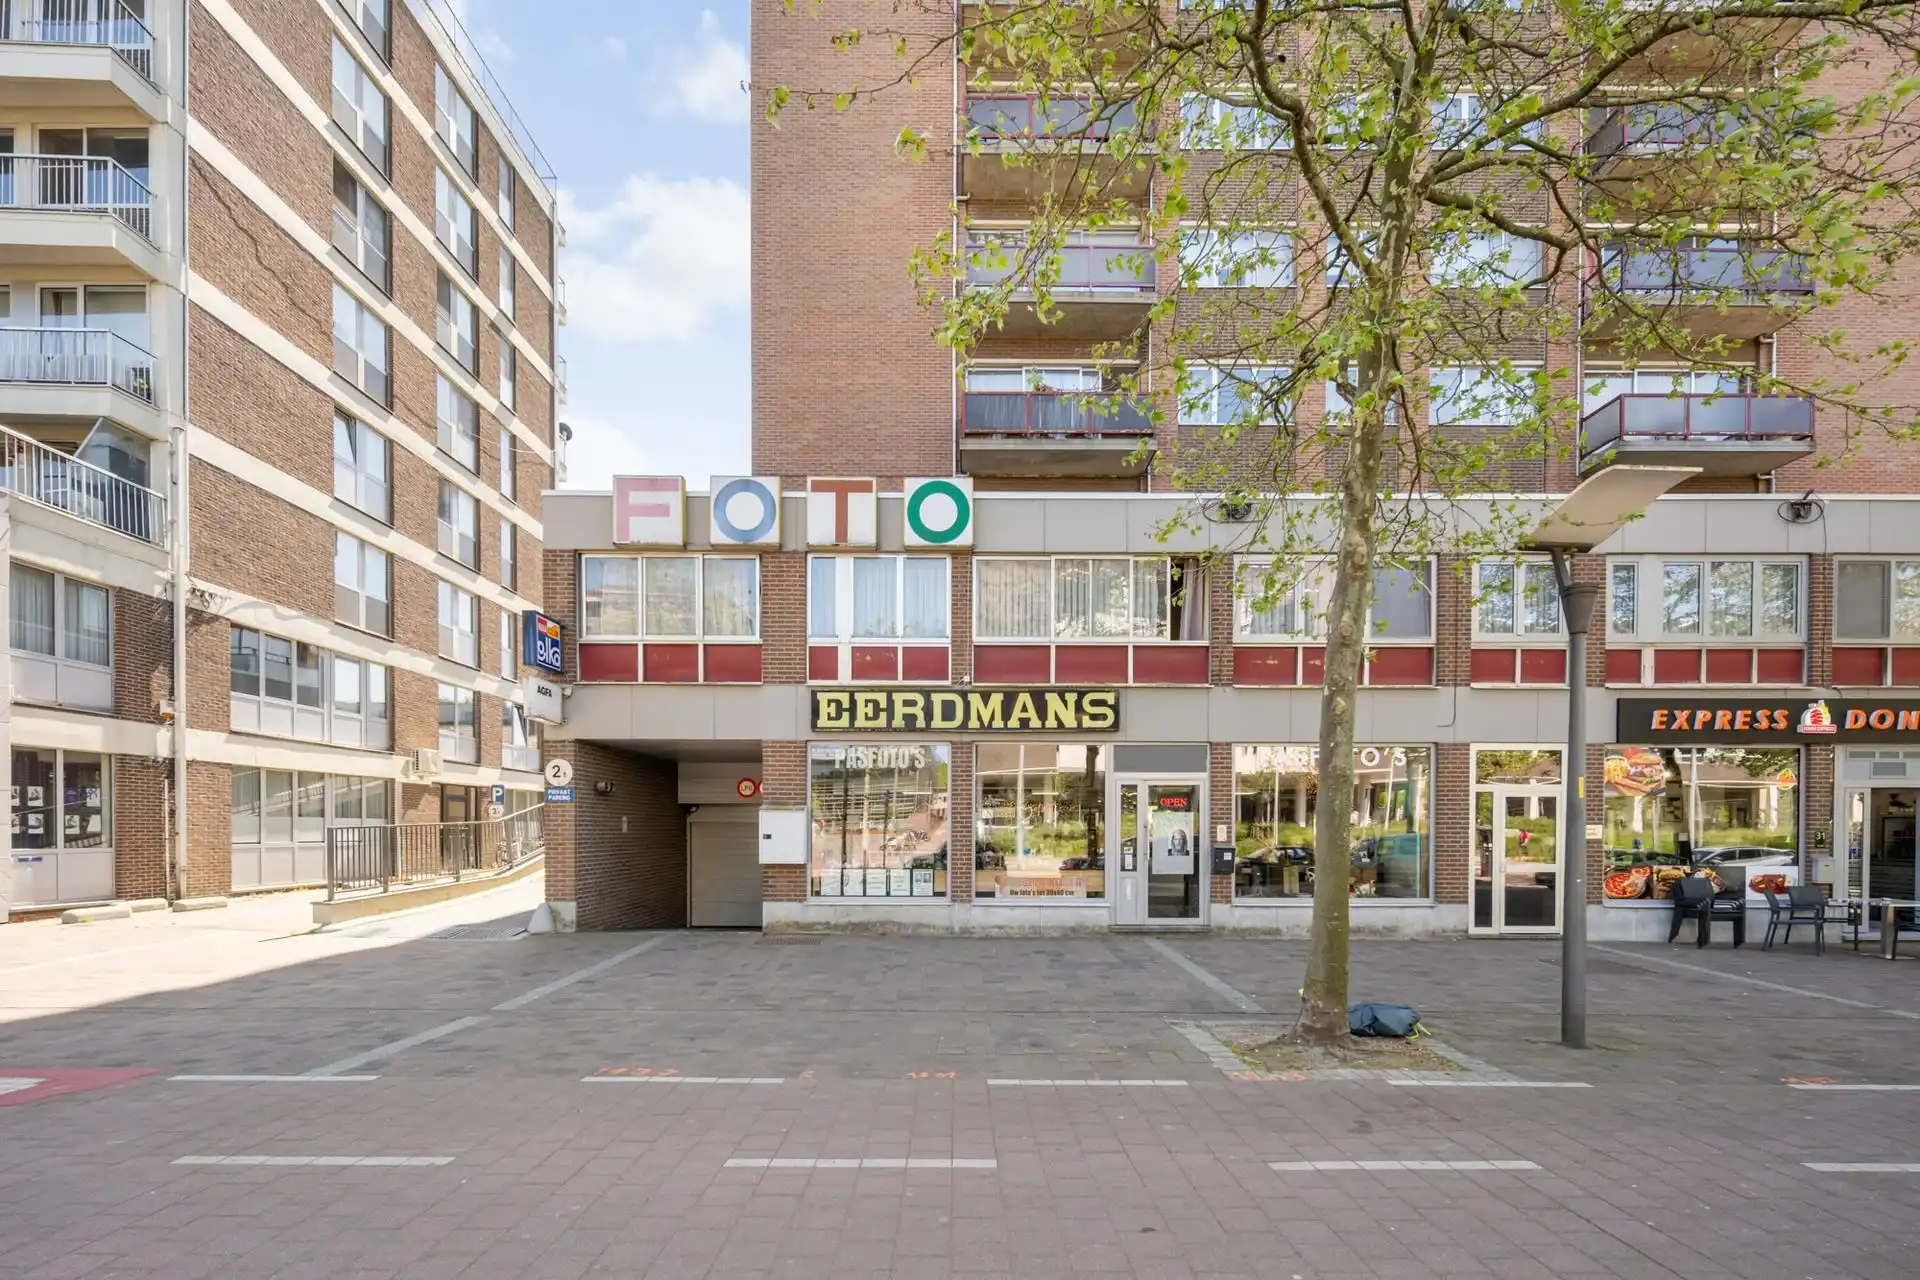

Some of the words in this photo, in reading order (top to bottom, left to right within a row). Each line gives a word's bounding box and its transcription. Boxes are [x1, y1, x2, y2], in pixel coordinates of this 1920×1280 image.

[614, 477, 971, 545] FOTO
[537, 684, 553, 698] AGFA
[816, 692, 1116, 729] EERDMANS
[1651, 708, 1790, 731] EXPRESS
[834, 745, 927, 769] PASFOTO'S
[492, 787, 503, 802] P
[1160, 797, 1188, 807] OPEN
[1815, 831, 1826, 840] 31
